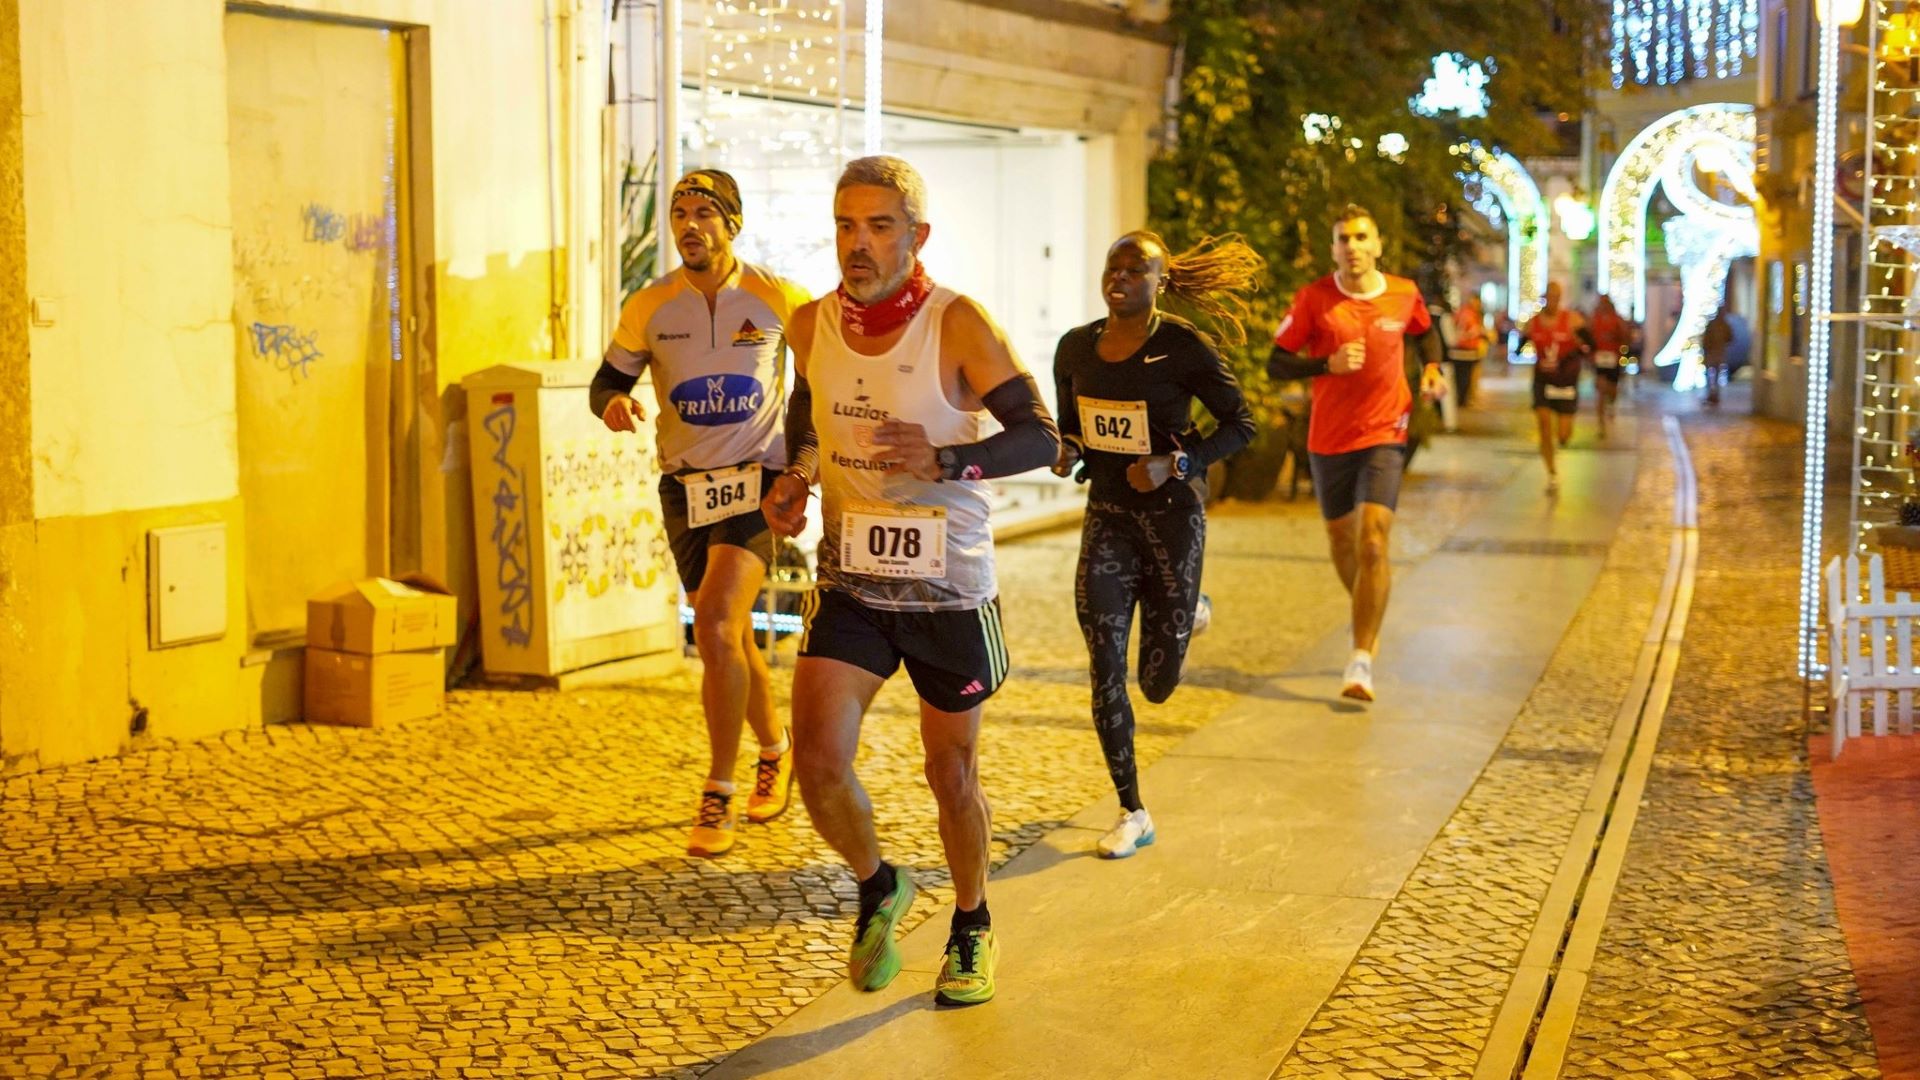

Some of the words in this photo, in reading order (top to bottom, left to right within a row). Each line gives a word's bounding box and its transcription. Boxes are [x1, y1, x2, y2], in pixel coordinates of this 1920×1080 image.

[678, 392, 760, 416] FRIMARC
[833, 402, 889, 421] Luzias
[1094, 415, 1133, 439] 642
[705, 482, 746, 511] 364
[868, 525, 921, 558] 078
[1152, 546, 1180, 598] NIKE
